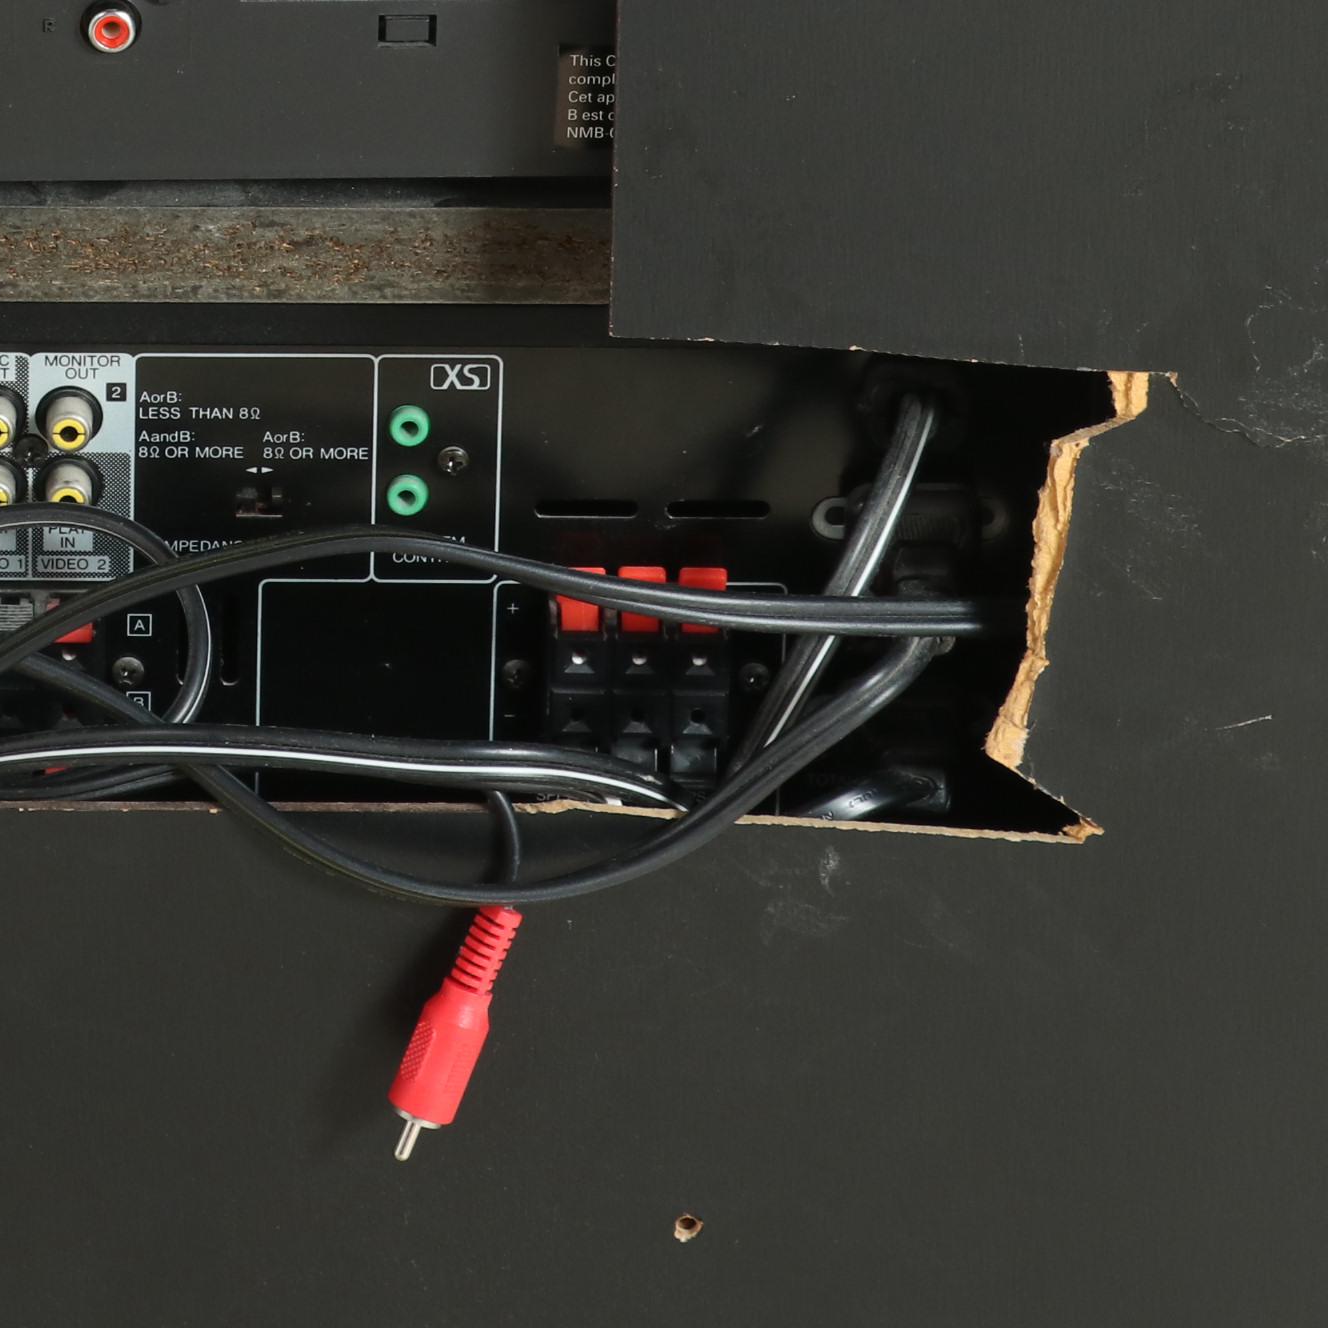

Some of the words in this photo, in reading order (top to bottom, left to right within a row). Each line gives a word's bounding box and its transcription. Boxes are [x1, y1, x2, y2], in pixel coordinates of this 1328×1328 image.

[42, 19, 56, 33] R
[570, 55, 601, 67] This
[568, 91, 592, 105] Cet
[44, 356, 121, 367] MONITOR
[65, 368, 98, 380] OUT
[111, 387, 121, 398] 2
[139, 407, 181, 420] LESS
[190, 407, 233, 420] THAN
[139, 431, 195, 442] AandB:
[164, 447, 189, 459] OR
[195, 447, 244, 459] MORE
[289, 447, 314, 459] OR
[320, 447, 369, 459] MORE
[60, 537, 75, 548] IN
[40, 558, 89, 570] VIDEO
[97, 558, 106, 570] 2
[134, 619, 145, 631] A
